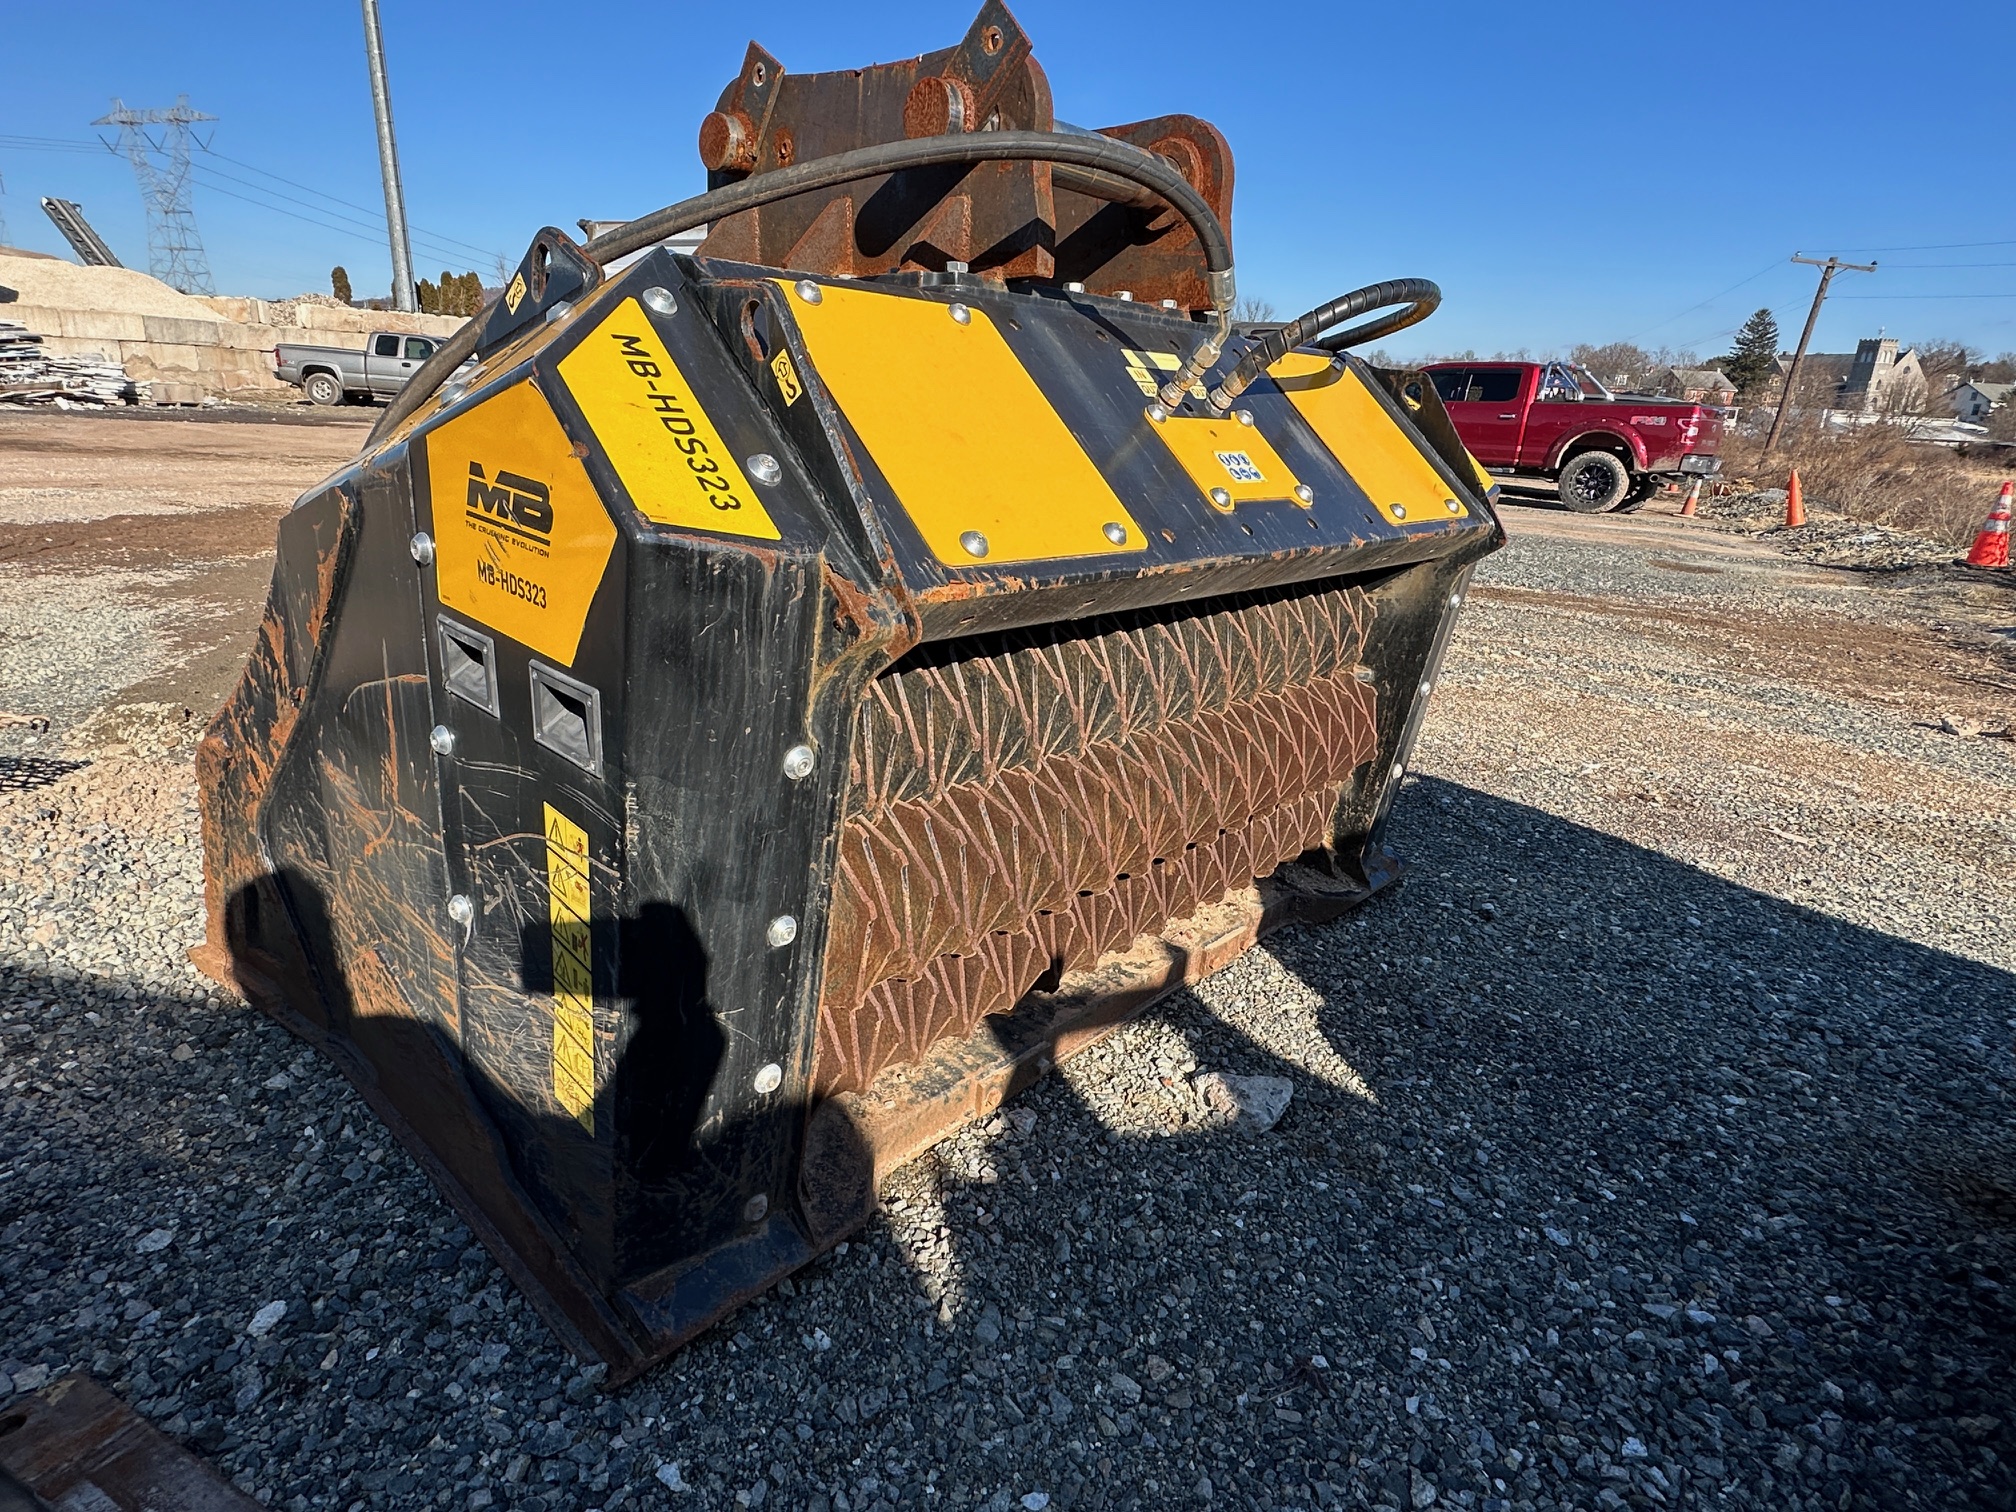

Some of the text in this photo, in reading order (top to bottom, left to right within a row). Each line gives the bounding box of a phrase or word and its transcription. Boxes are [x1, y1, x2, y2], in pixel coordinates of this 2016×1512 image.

[611, 334, 742, 511] MB-HDS323
[466, 460, 554, 535] MB
[465, 520, 477, 531] THE
[511, 538, 550, 559] EVOLUTION
[477, 558, 547, 609] MB-HDS323
